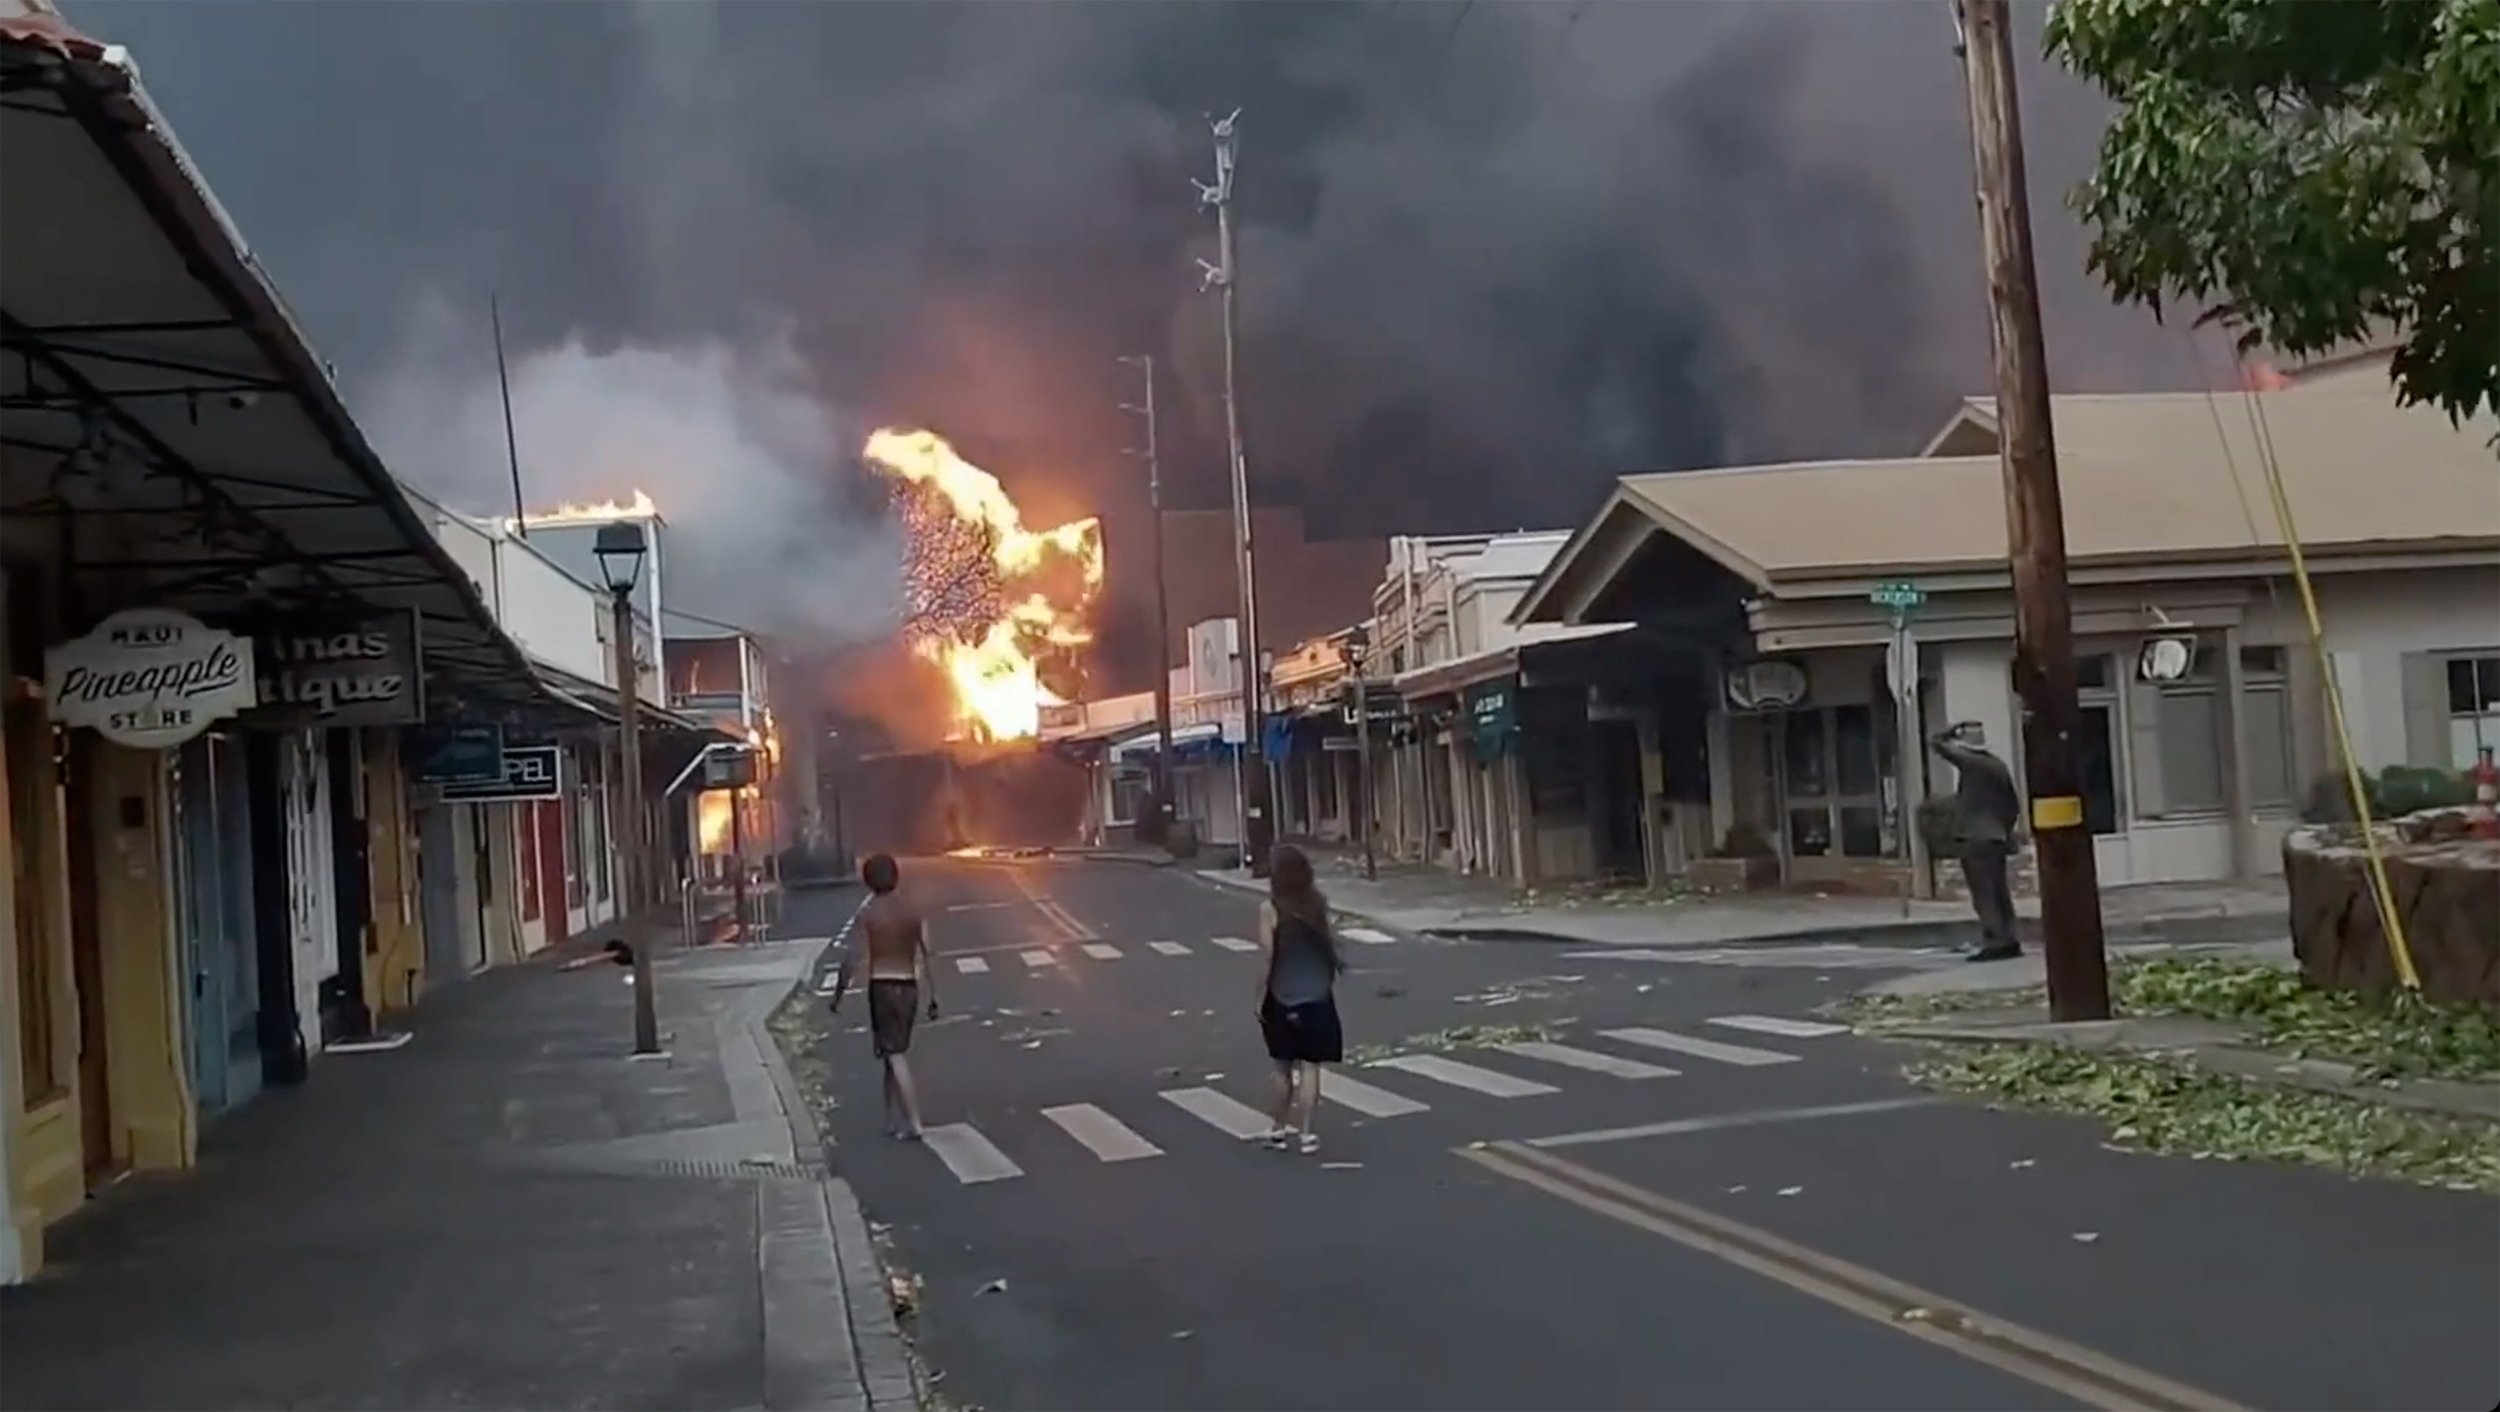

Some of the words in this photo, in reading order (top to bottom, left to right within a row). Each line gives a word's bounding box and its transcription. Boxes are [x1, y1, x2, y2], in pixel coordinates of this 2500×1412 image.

[112, 624, 182, 643] MAUI
[272, 632, 389, 661] inas
[57, 643, 239, 705] Pineapple
[502, 758, 553, 781] PEL
